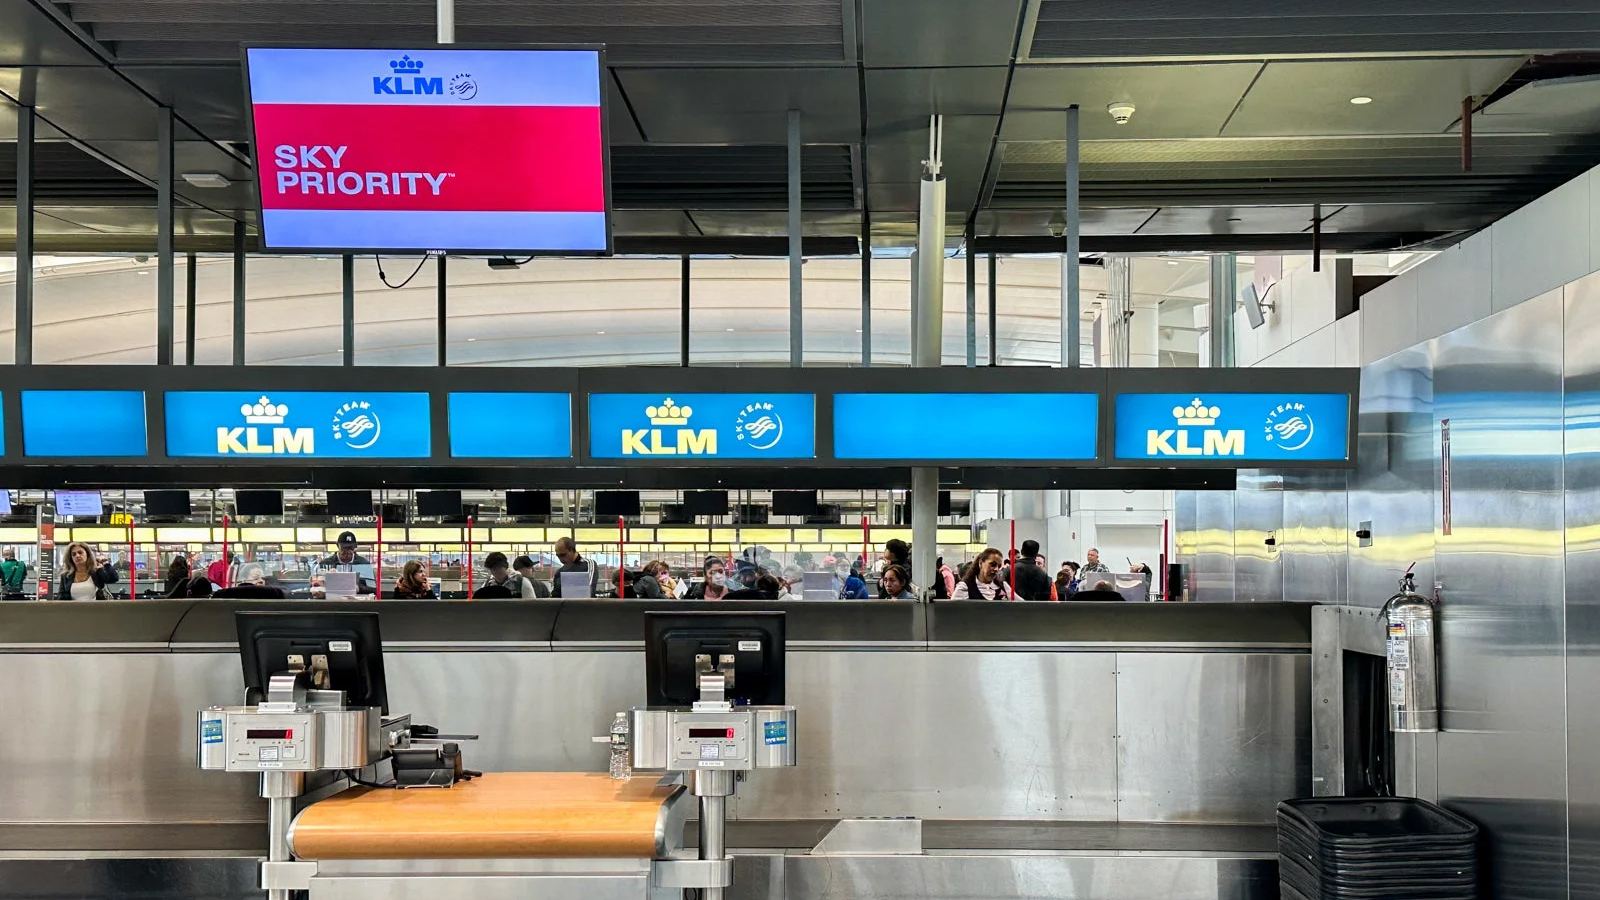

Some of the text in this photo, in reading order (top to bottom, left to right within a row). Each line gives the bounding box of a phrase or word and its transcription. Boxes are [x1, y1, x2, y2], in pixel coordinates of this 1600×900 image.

[373, 77, 443, 95] KLM
[275, 145, 347, 169] SKY
[332, 401, 371, 440] SKYTEAM
[736, 402, 773, 440] SKYTEAM
[1265, 402, 1304, 441] SKYTEAM
[217, 427, 314, 454] KLM
[622, 429, 717, 454] KLM
[1147, 430, 1245, 455] KLM
